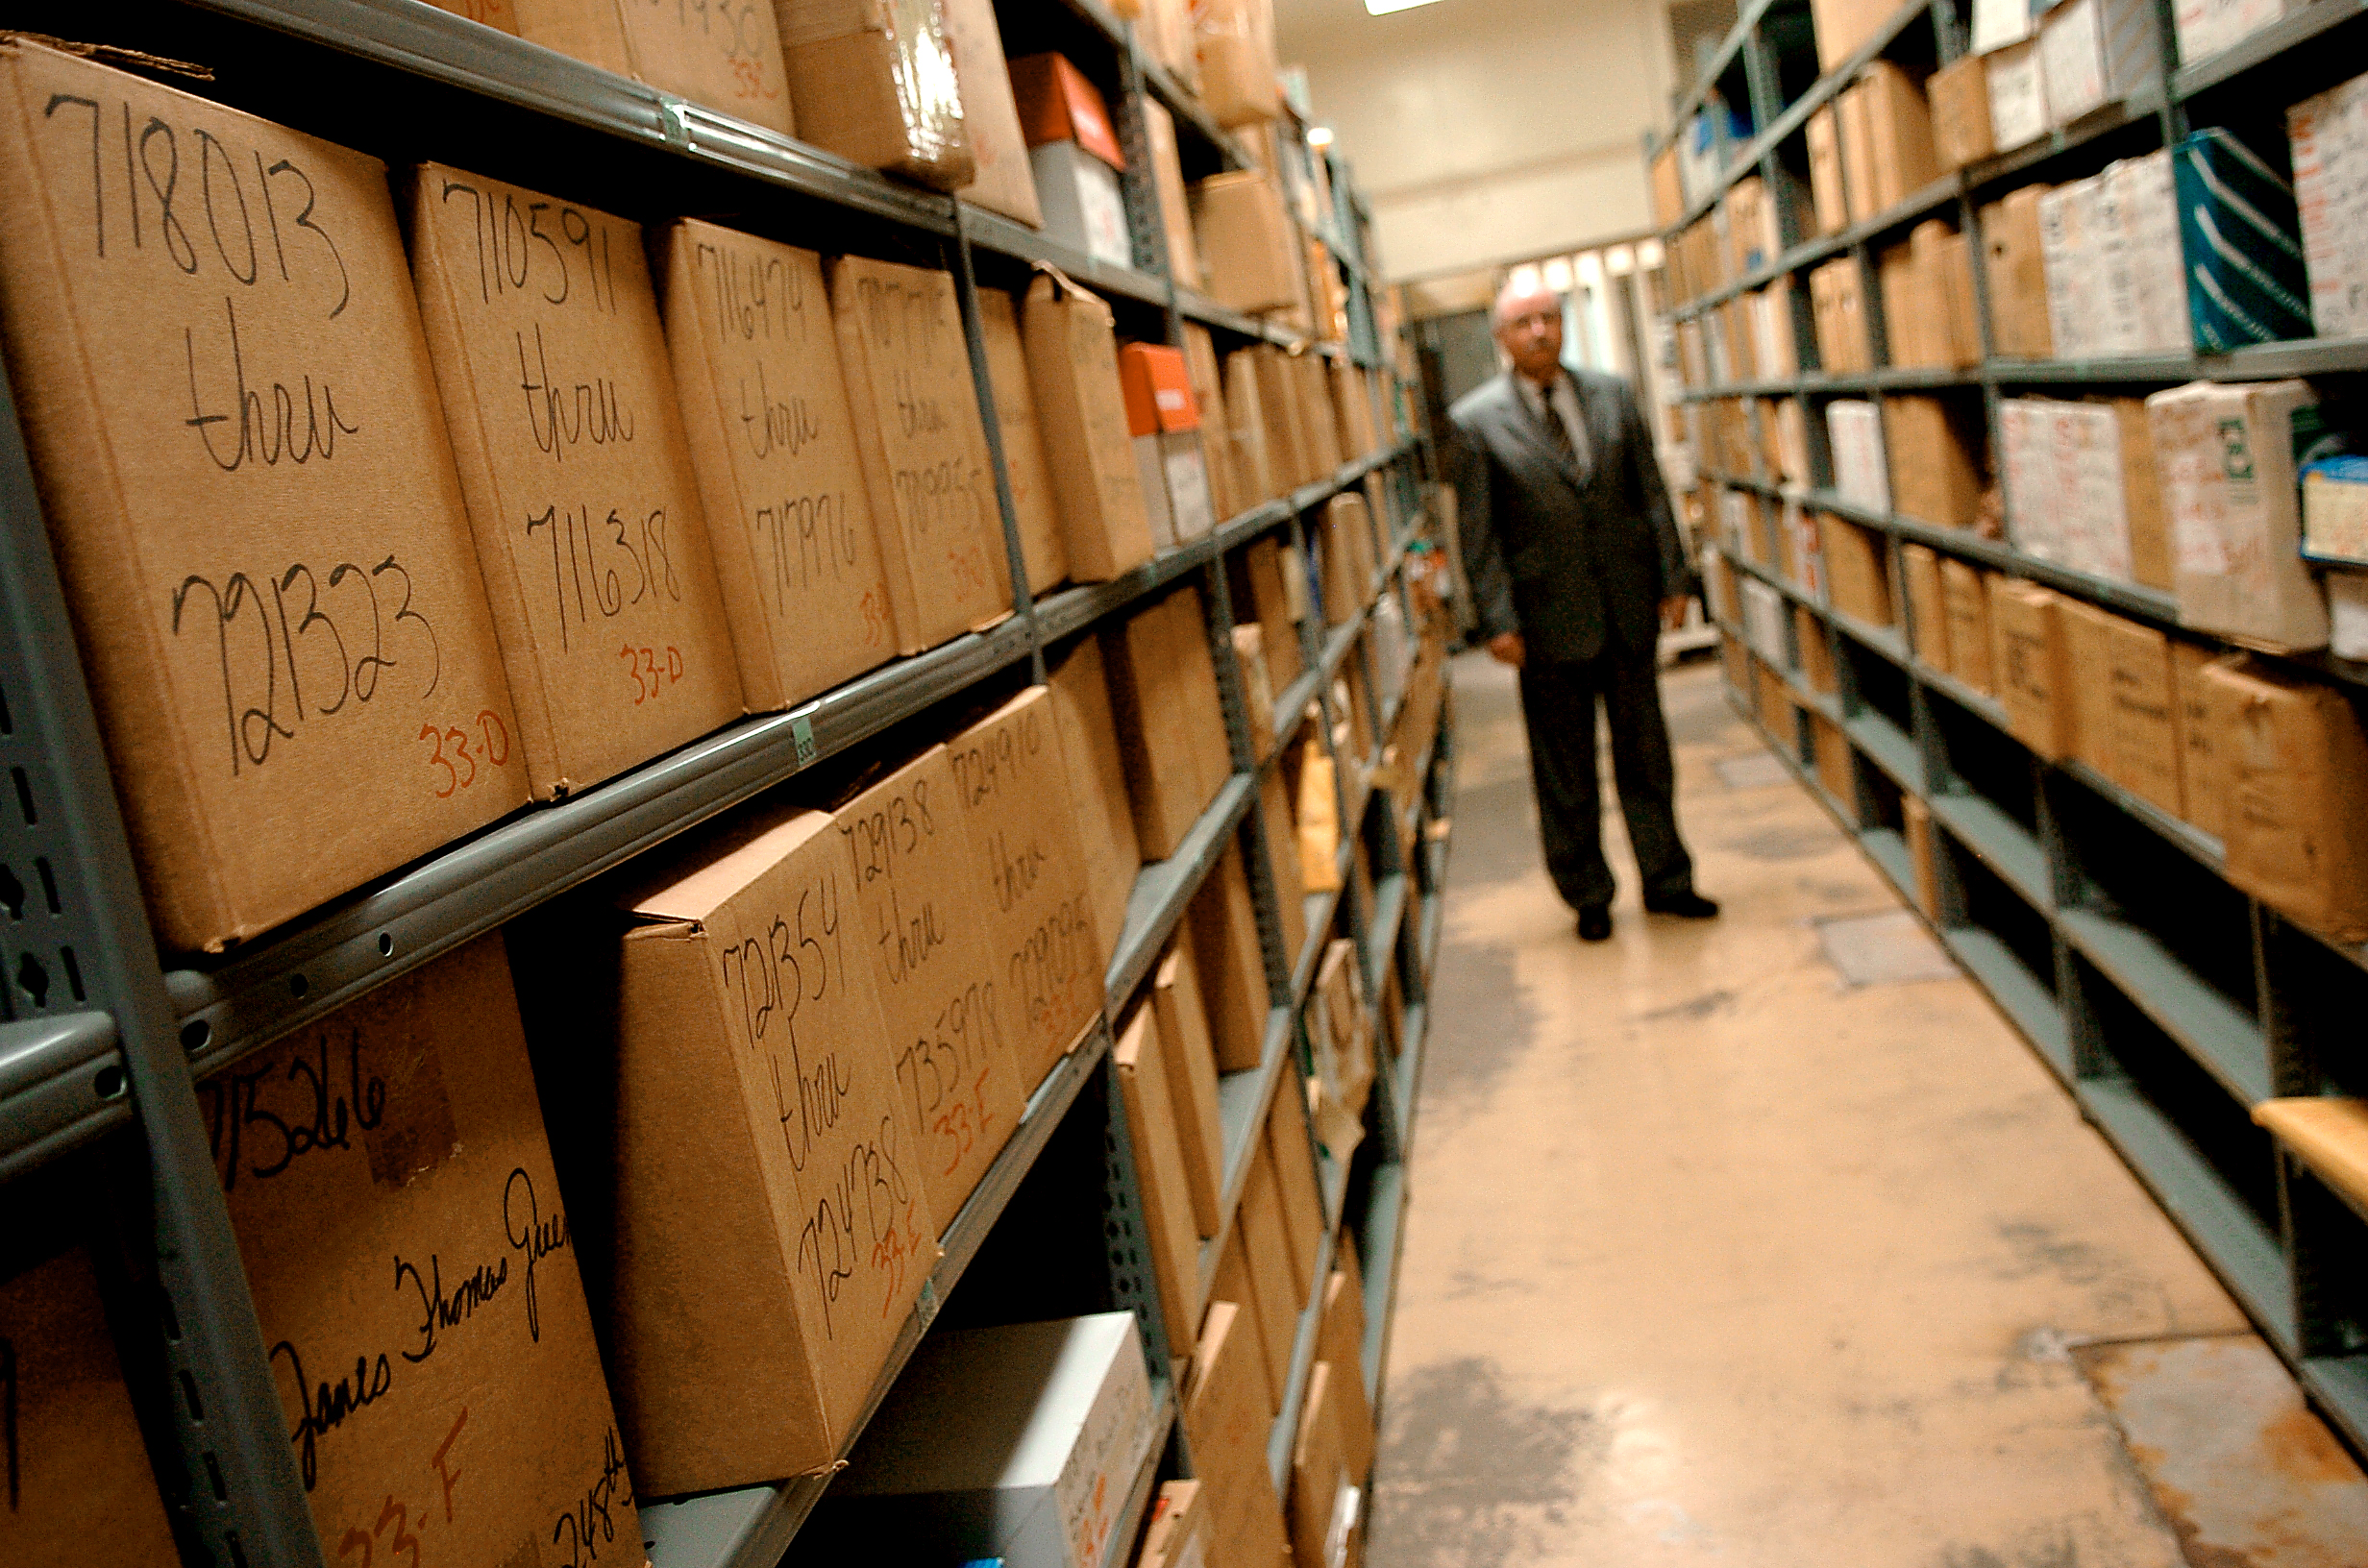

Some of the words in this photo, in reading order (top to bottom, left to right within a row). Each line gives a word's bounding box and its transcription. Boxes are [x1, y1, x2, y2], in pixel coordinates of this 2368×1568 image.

[44, 93, 350, 319] 718013
[442, 179, 616, 315] 710591
[185, 296, 358, 471] thru
[516, 323, 634, 462] thru
[740, 360, 819, 459] thru
[527, 503, 680, 654] 716318
[171, 554, 439, 776] 721323
[621, 644, 683, 705] 33-D
[419, 709, 508, 798] 33-D
[840, 777, 936, 894] 729138
[987, 828, 1047, 914] thru
[723, 871, 845, 1050] 721354
[877, 886, 947, 986] thru
[773, 1019, 852, 1172] thru
[798, 1112, 908, 1341] 724738
[269, 1340, 391, 1493] James
[394, 1253, 507, 1363] Thomas
